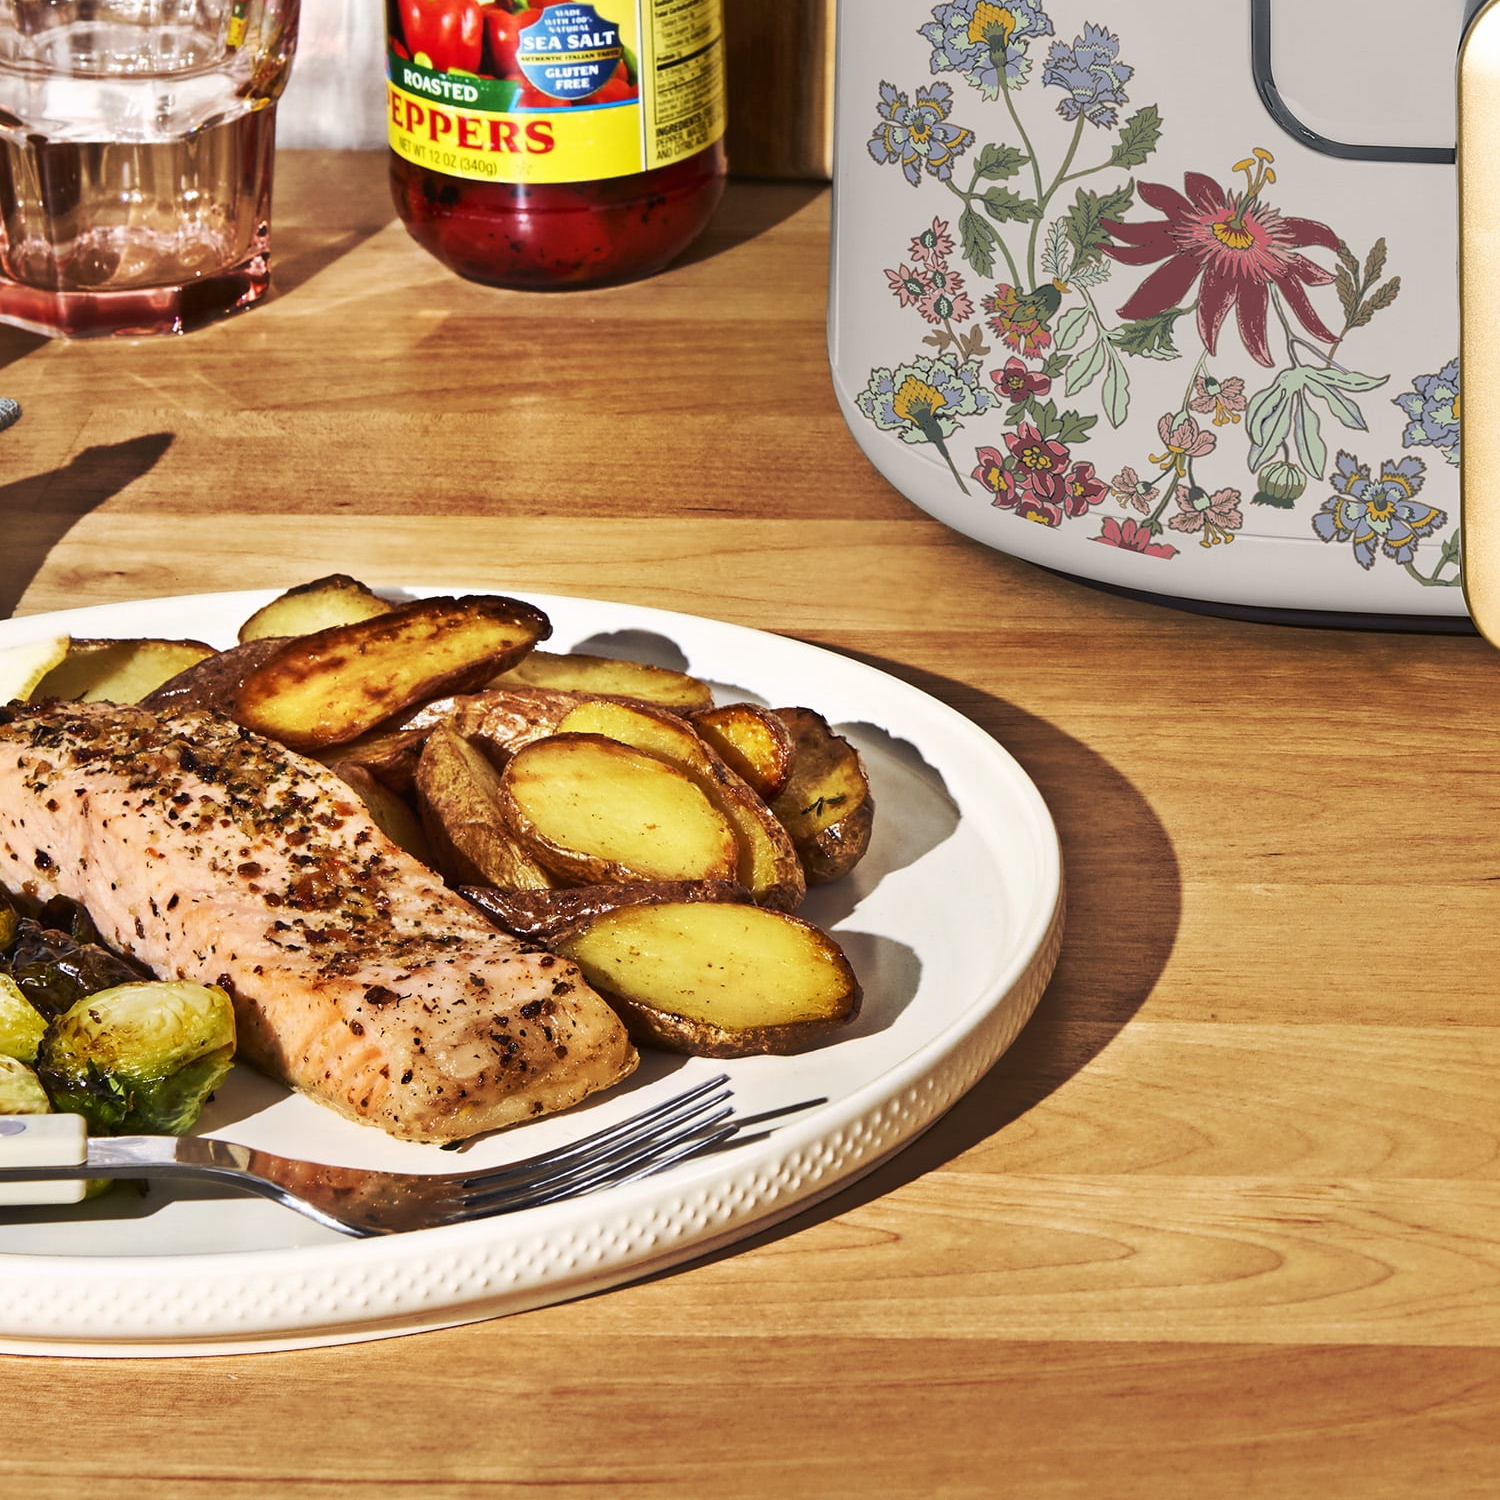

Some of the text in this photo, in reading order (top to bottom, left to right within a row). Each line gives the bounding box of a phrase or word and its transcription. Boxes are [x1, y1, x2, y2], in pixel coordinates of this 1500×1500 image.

[523, 30, 615, 50] SEA SALT
[544, 65, 599, 79] GLUTEN
[403, 68, 479, 102] ROASTED
[555, 78, 590, 90] FREE
[399, 136, 498, 176] NET WT 12 OZ (340g)
